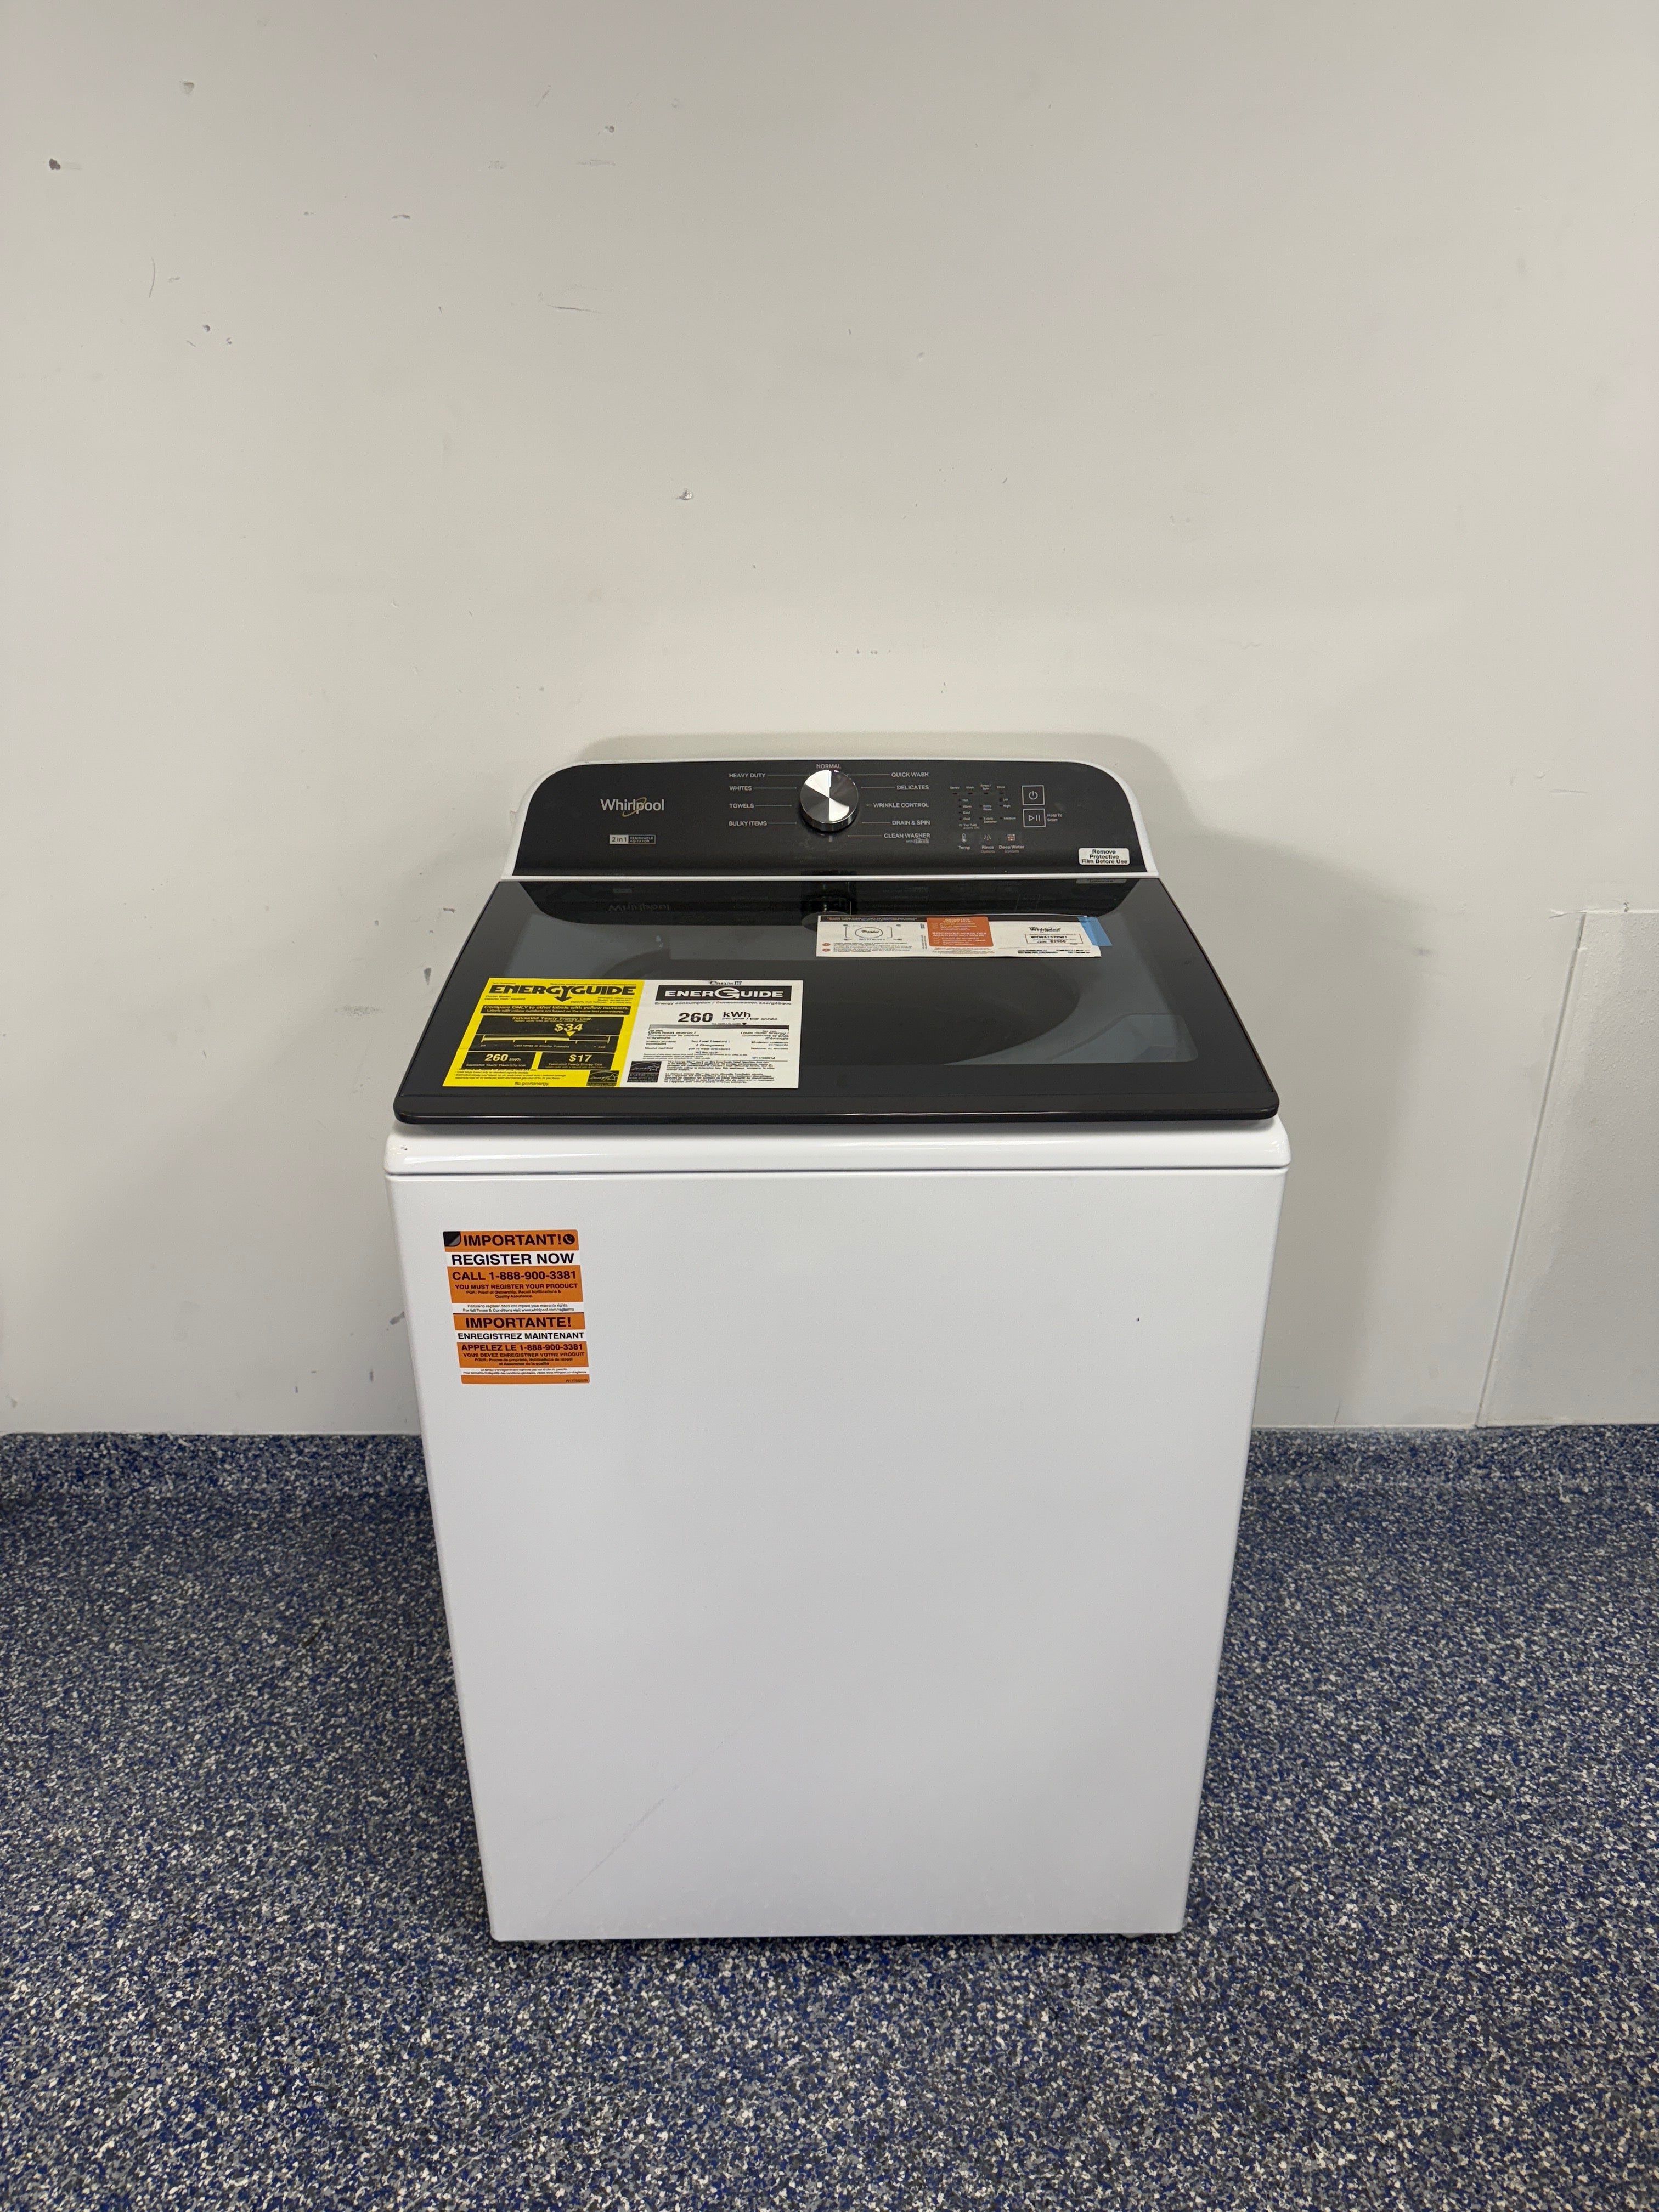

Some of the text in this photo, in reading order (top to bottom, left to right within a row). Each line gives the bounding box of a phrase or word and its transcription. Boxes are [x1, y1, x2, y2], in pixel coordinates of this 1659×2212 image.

[600, 799, 664, 814] Whirlpool
[489, 985, 636, 996] ENERGYGUIDE
[664, 988, 783, 999] ENERGUIDE
[678, 1013, 713, 1023] 260
[554, 1024, 583, 1032] $34
[485, 1053, 509, 1062] 260
[464, 1234, 561, 1246] IMPORTANT!
[452, 1253, 574, 1265] REGISTER NOW
[452, 1271, 576, 1280] CALL 1-888-900-3381
[466, 1317, 571, 1328] IMPORTANTE!
